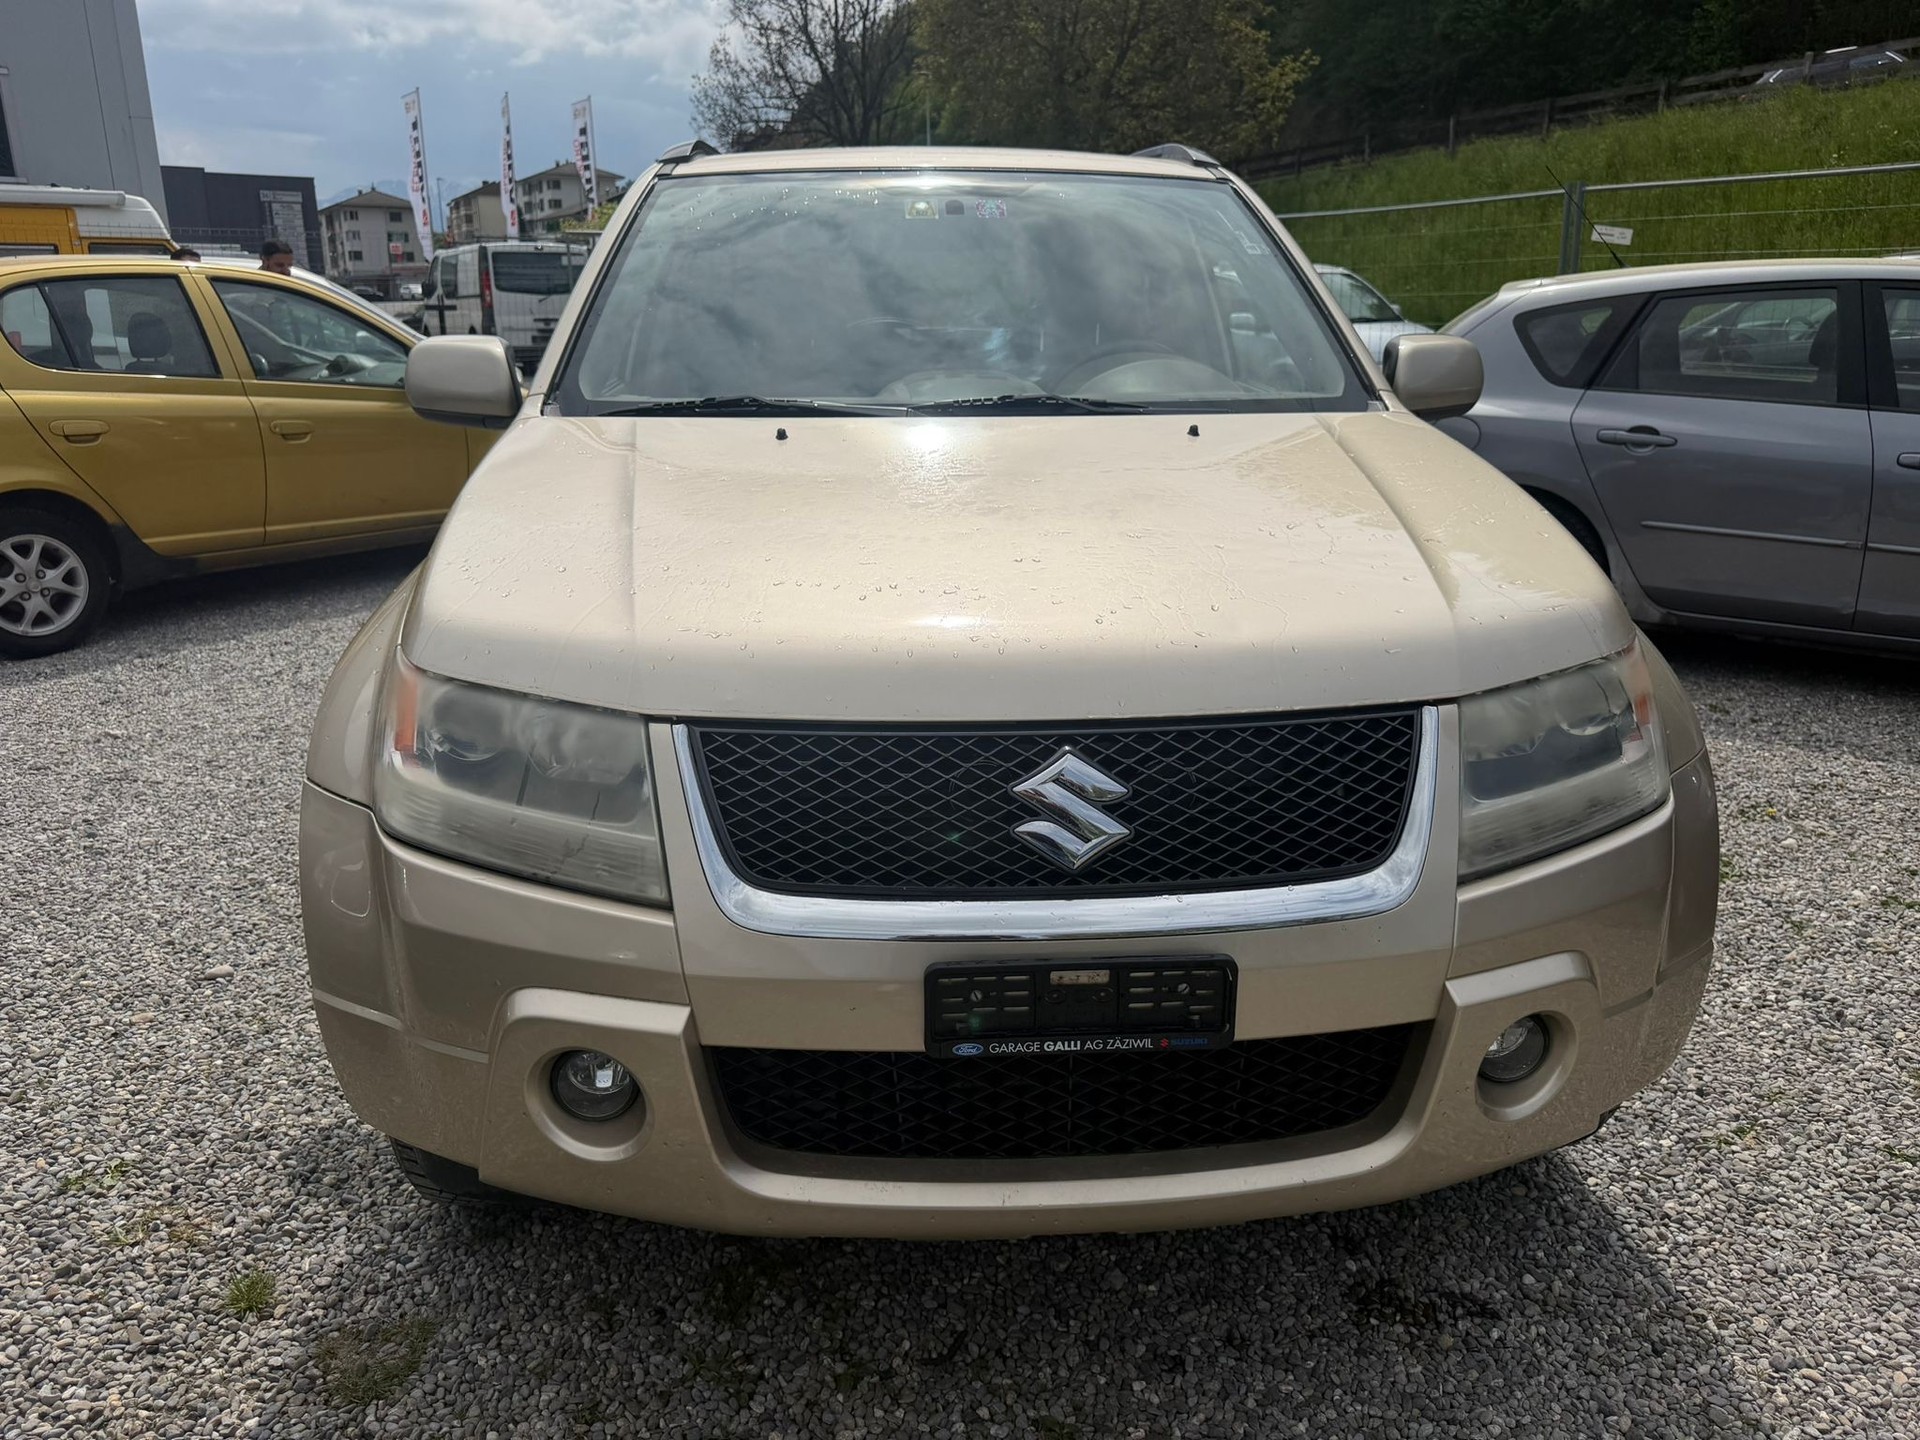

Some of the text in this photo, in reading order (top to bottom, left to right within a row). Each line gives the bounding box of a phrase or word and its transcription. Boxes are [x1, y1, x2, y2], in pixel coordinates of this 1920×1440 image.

[989, 1036, 1154, 1054] GARAGE GALLI AG ZÄZIWIL
